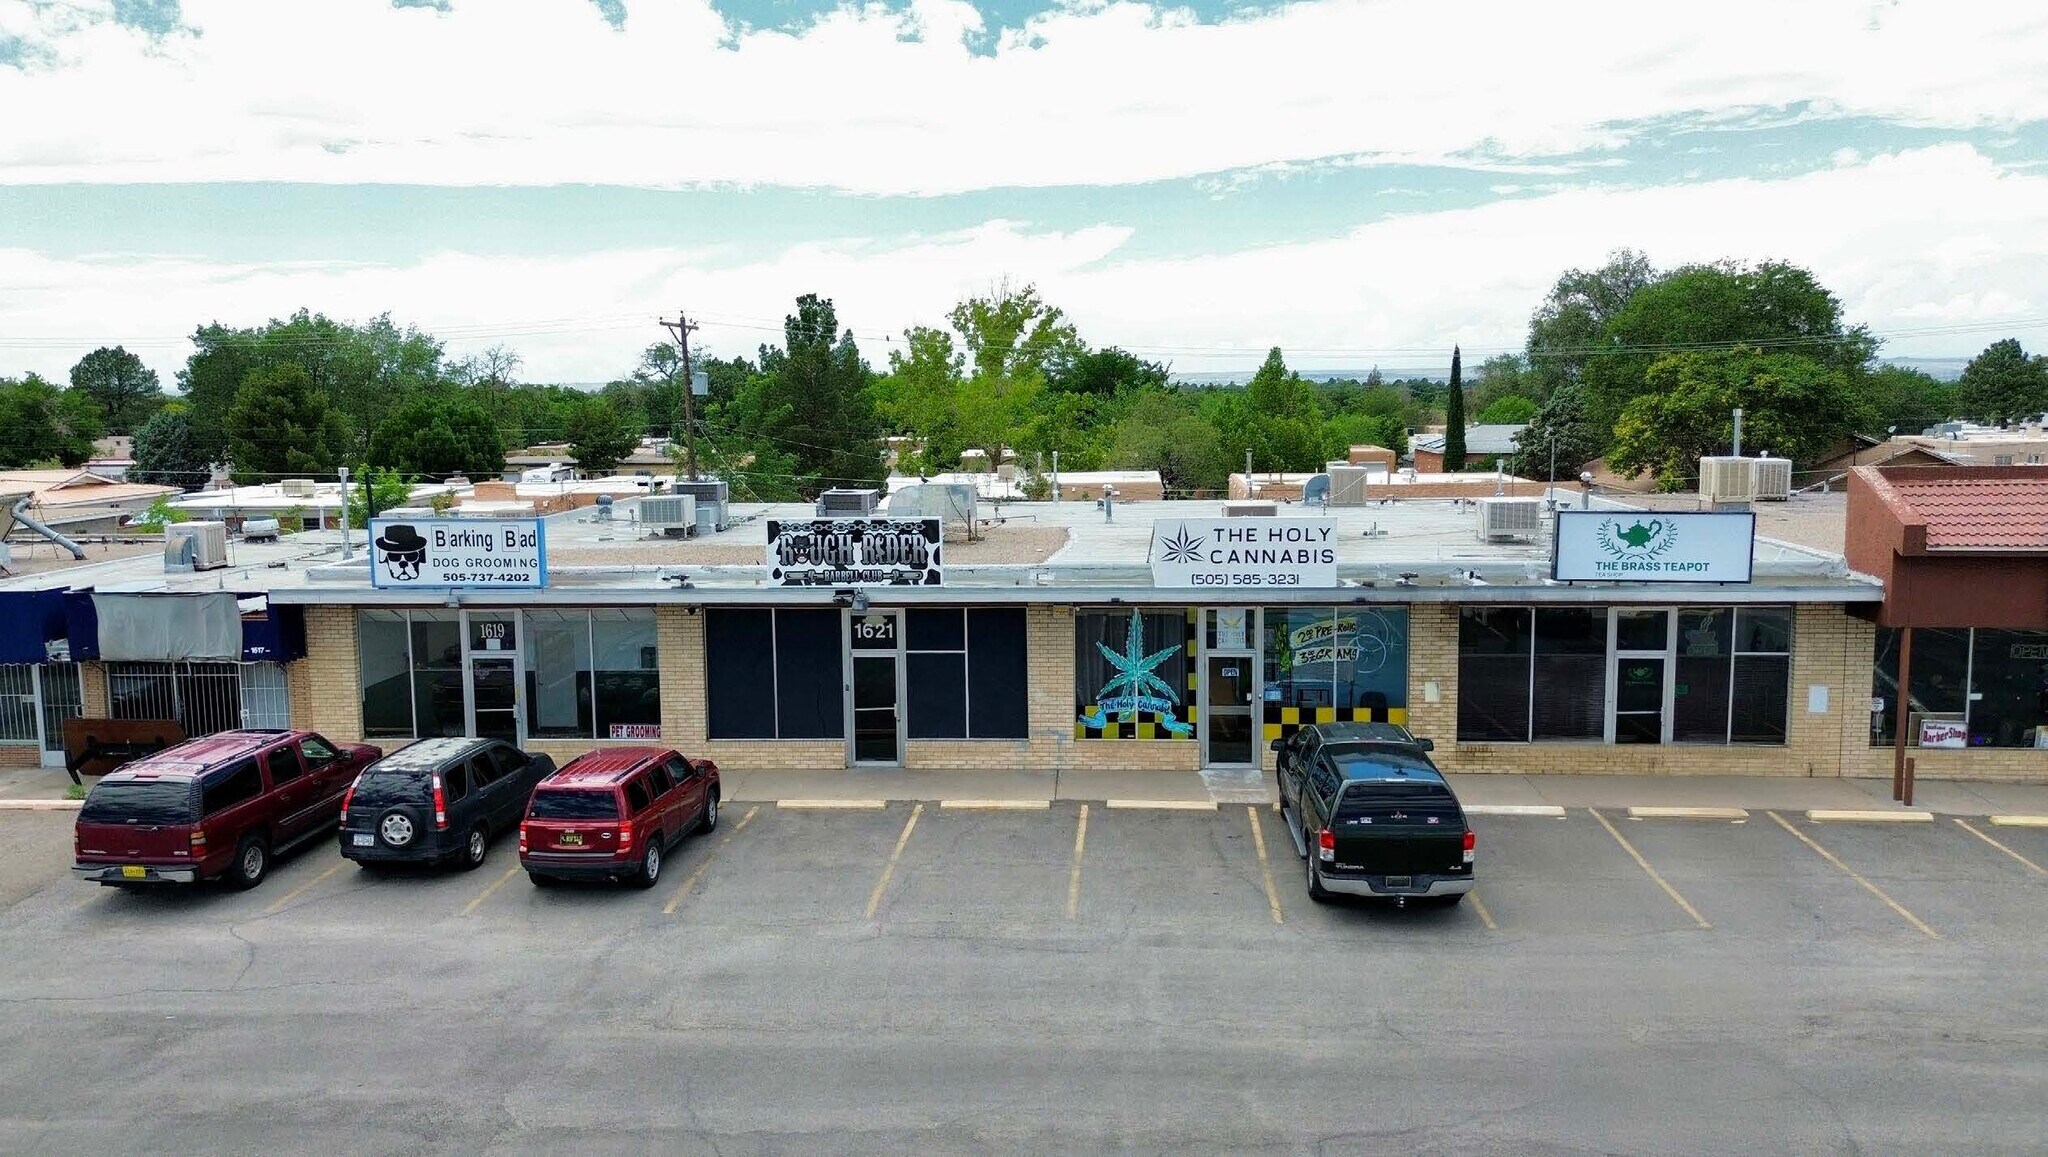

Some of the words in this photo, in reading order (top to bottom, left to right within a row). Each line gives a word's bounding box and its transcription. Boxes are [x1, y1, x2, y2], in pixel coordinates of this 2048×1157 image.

[435, 529, 493, 552] Barking
[505, 529, 536, 548] Bad
[1213, 528, 1257, 542] THE
[1269, 527, 1331, 542] HOLY
[433, 558, 460, 568] DOG
[465, 558, 538, 568] GROOMING
[1210, 549, 1335, 564] CANNABIS
[1596, 561, 1619, 571] THE
[1621, 561, 1661, 571] BRASS
[1665, 562, 1710, 572] TEAPOT
[443, 573, 530, 582] 505-737-4202
[824, 570, 861, 582] BARBELL
[862, 570, 883, 582] CLUB
[1191, 574, 1229, 586] (505)
[1233, 574, 1300, 585] 585-3231
[480, 623, 505, 638] 1619
[854, 623, 893, 639] 1621
[611, 725, 624, 738] PET
[626, 725, 661, 738] GROOMING
